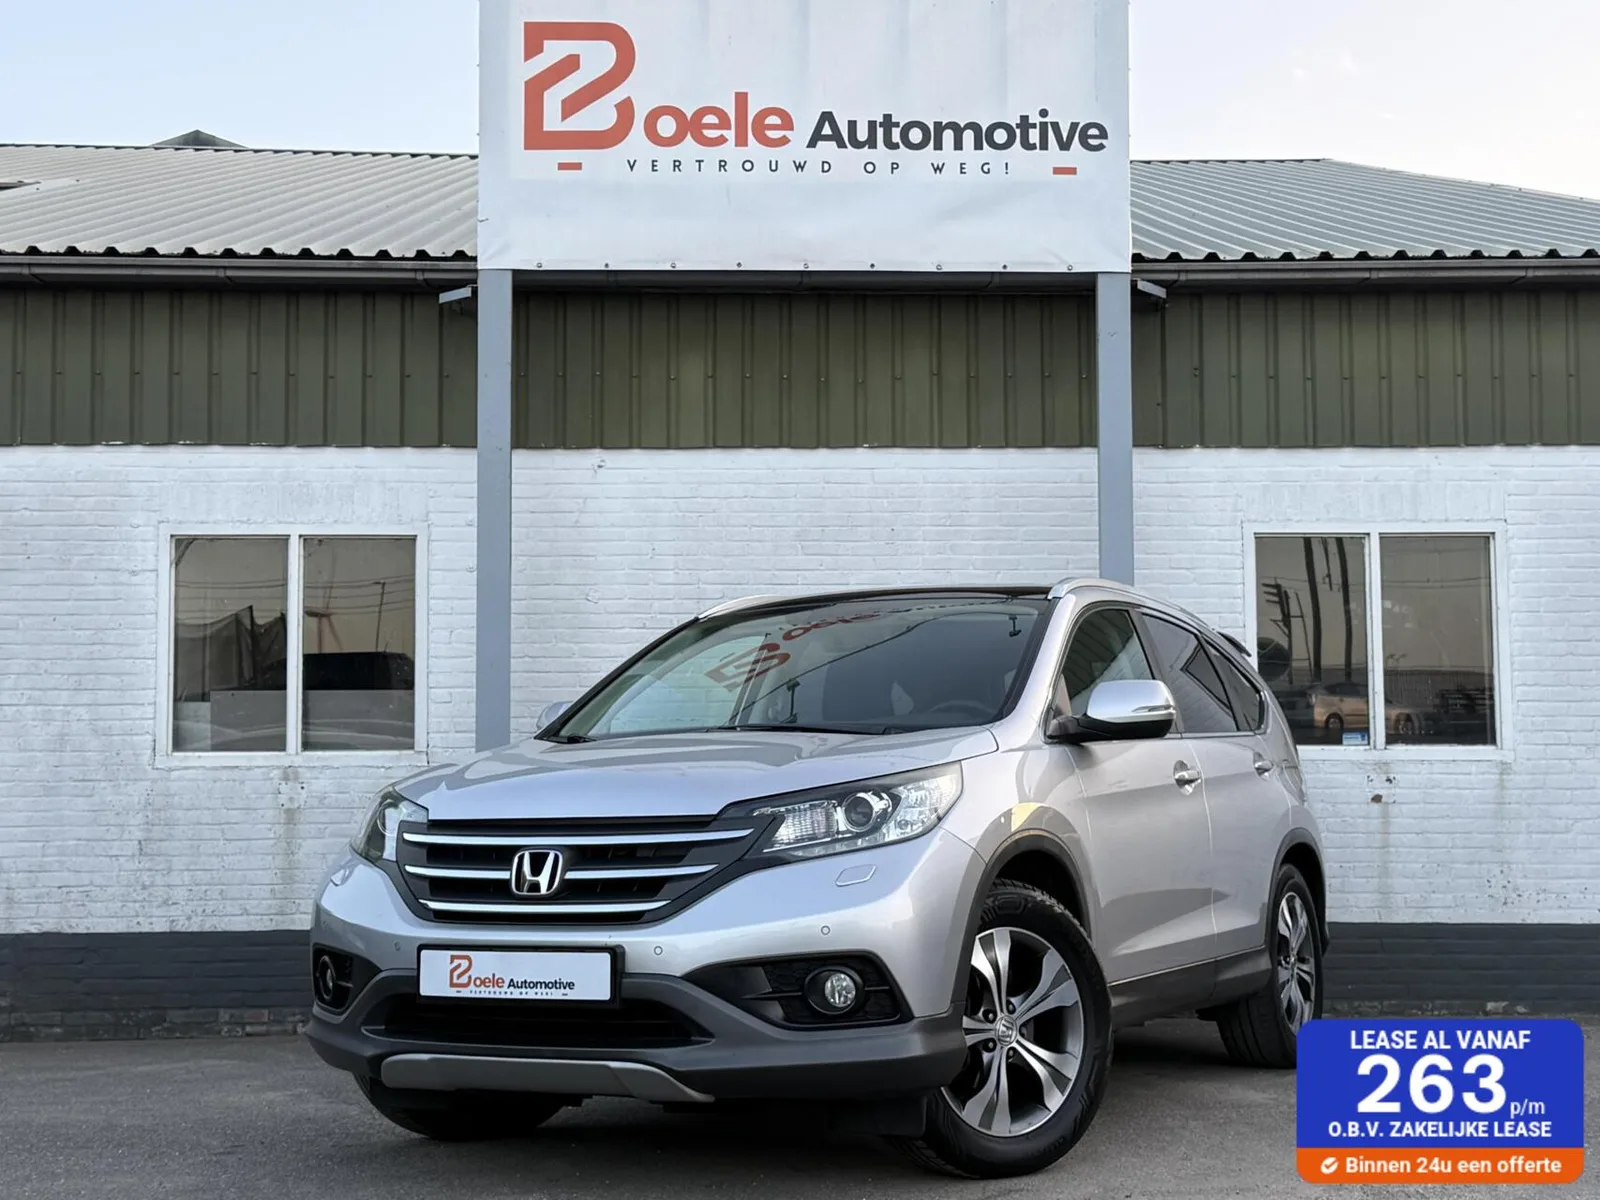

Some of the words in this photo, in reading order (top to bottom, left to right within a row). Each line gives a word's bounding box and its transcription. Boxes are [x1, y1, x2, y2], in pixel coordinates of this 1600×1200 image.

[806, 108, 1109, 152] Automotive
[627, 159, 833, 174] VERTROUWD
[863, 161, 901, 175] OP
[931, 162, 1010, 175] WEG!
[507, 978, 576, 991] Automotive
